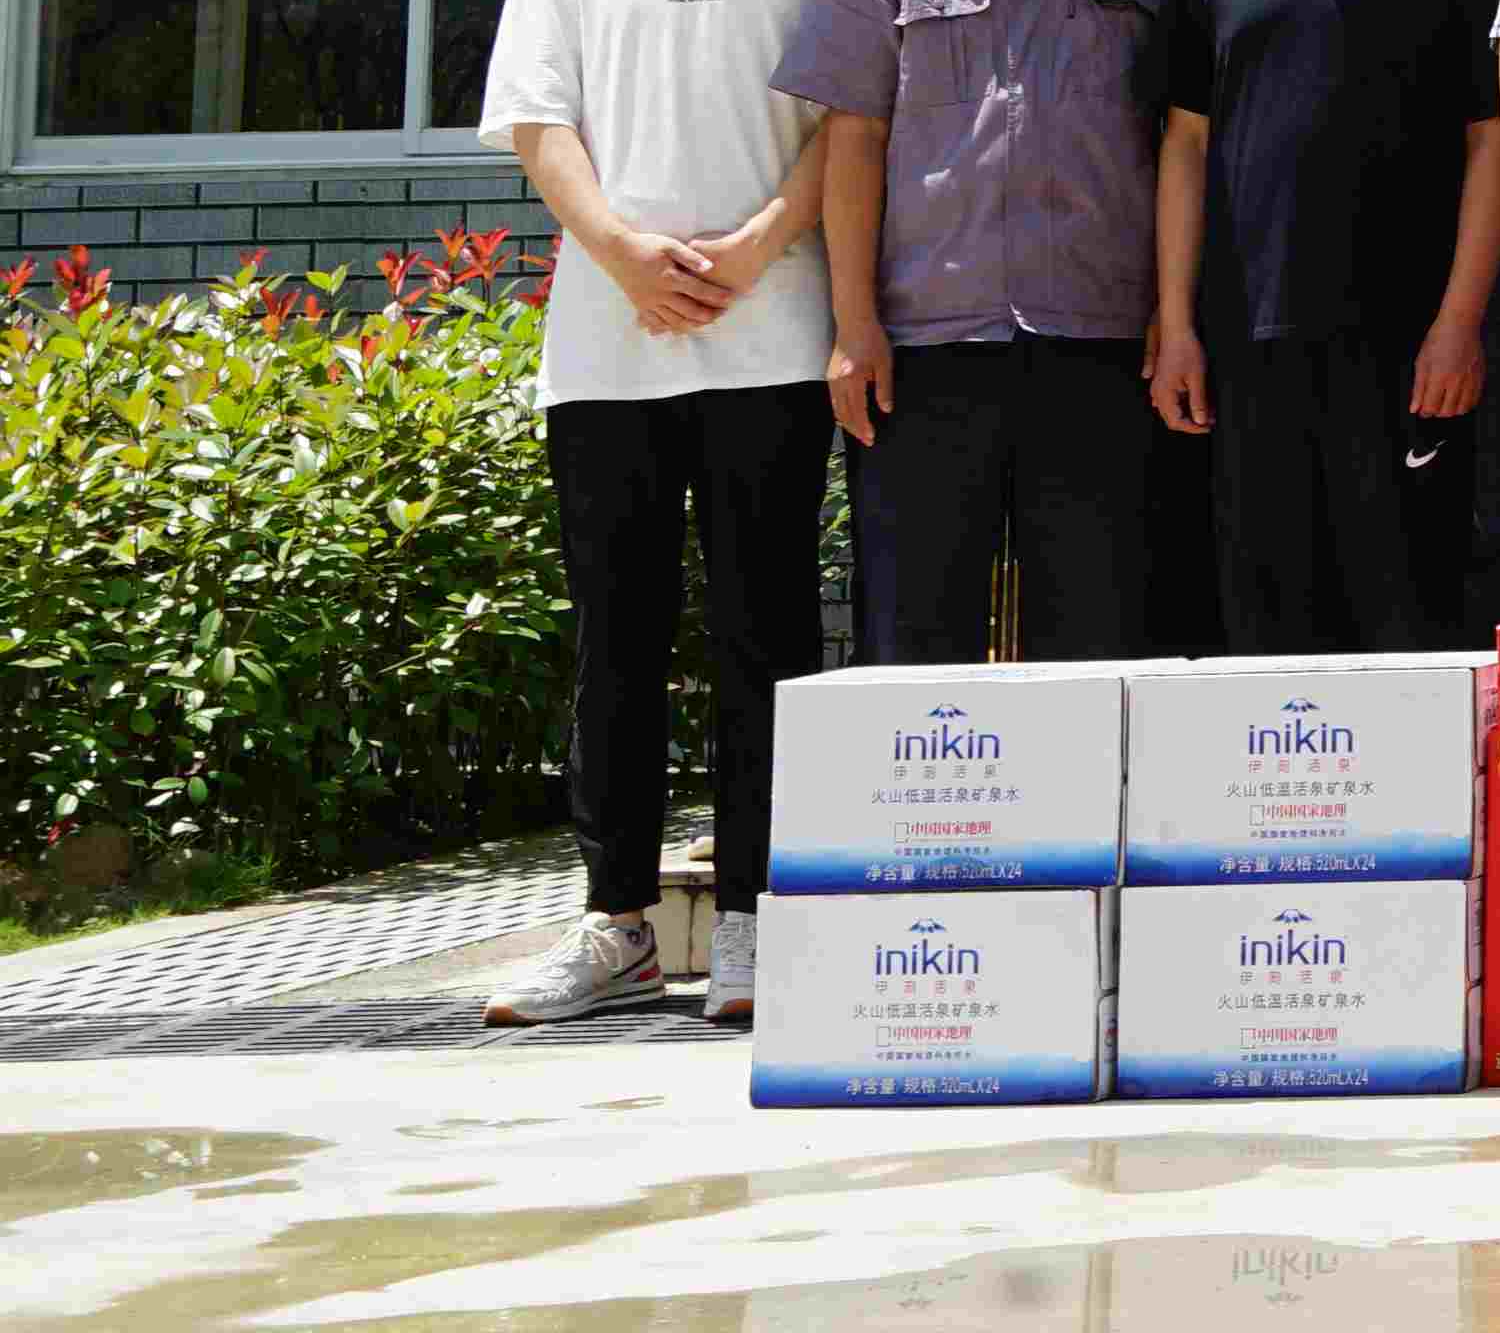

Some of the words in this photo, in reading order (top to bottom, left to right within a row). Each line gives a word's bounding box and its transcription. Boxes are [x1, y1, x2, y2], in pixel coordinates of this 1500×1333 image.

[894, 724, 1001, 760] inikin
[1249, 719, 1353, 754] inikin
[871, 786, 1019, 805] 火山低温活泉矿泉水
[1226, 781, 1376, 797] 火山低温活泉矿泉水
[875, 939, 980, 976] inikin
[1240, 929, 1346, 967] inikin
[853, 1002, 1001, 1020] 火山低温活泉矿泉水
[1217, 992, 1367, 1011] 火山低温活泉矿泉水
